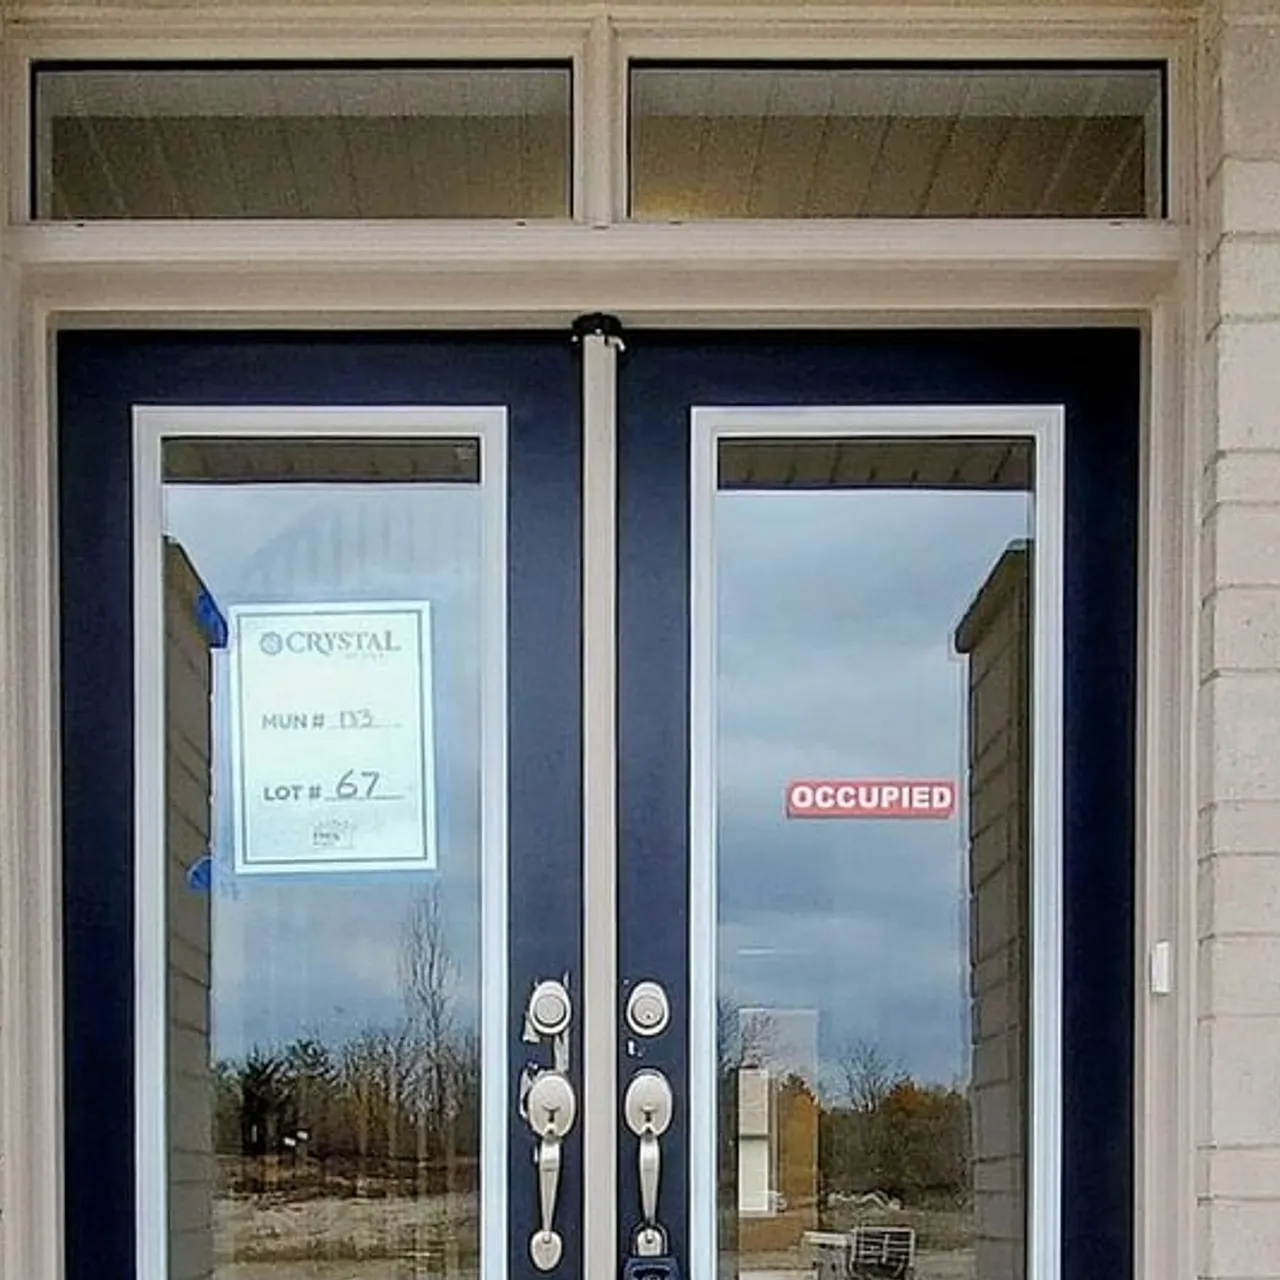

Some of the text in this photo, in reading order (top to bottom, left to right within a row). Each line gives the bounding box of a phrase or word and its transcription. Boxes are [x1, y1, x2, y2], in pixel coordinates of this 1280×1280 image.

[285, 630, 402, 657] CRYSTAL
[263, 784, 304, 801] LOT
[335, 768, 380, 800] 67
[791, 786, 952, 808] OCCUPIED
